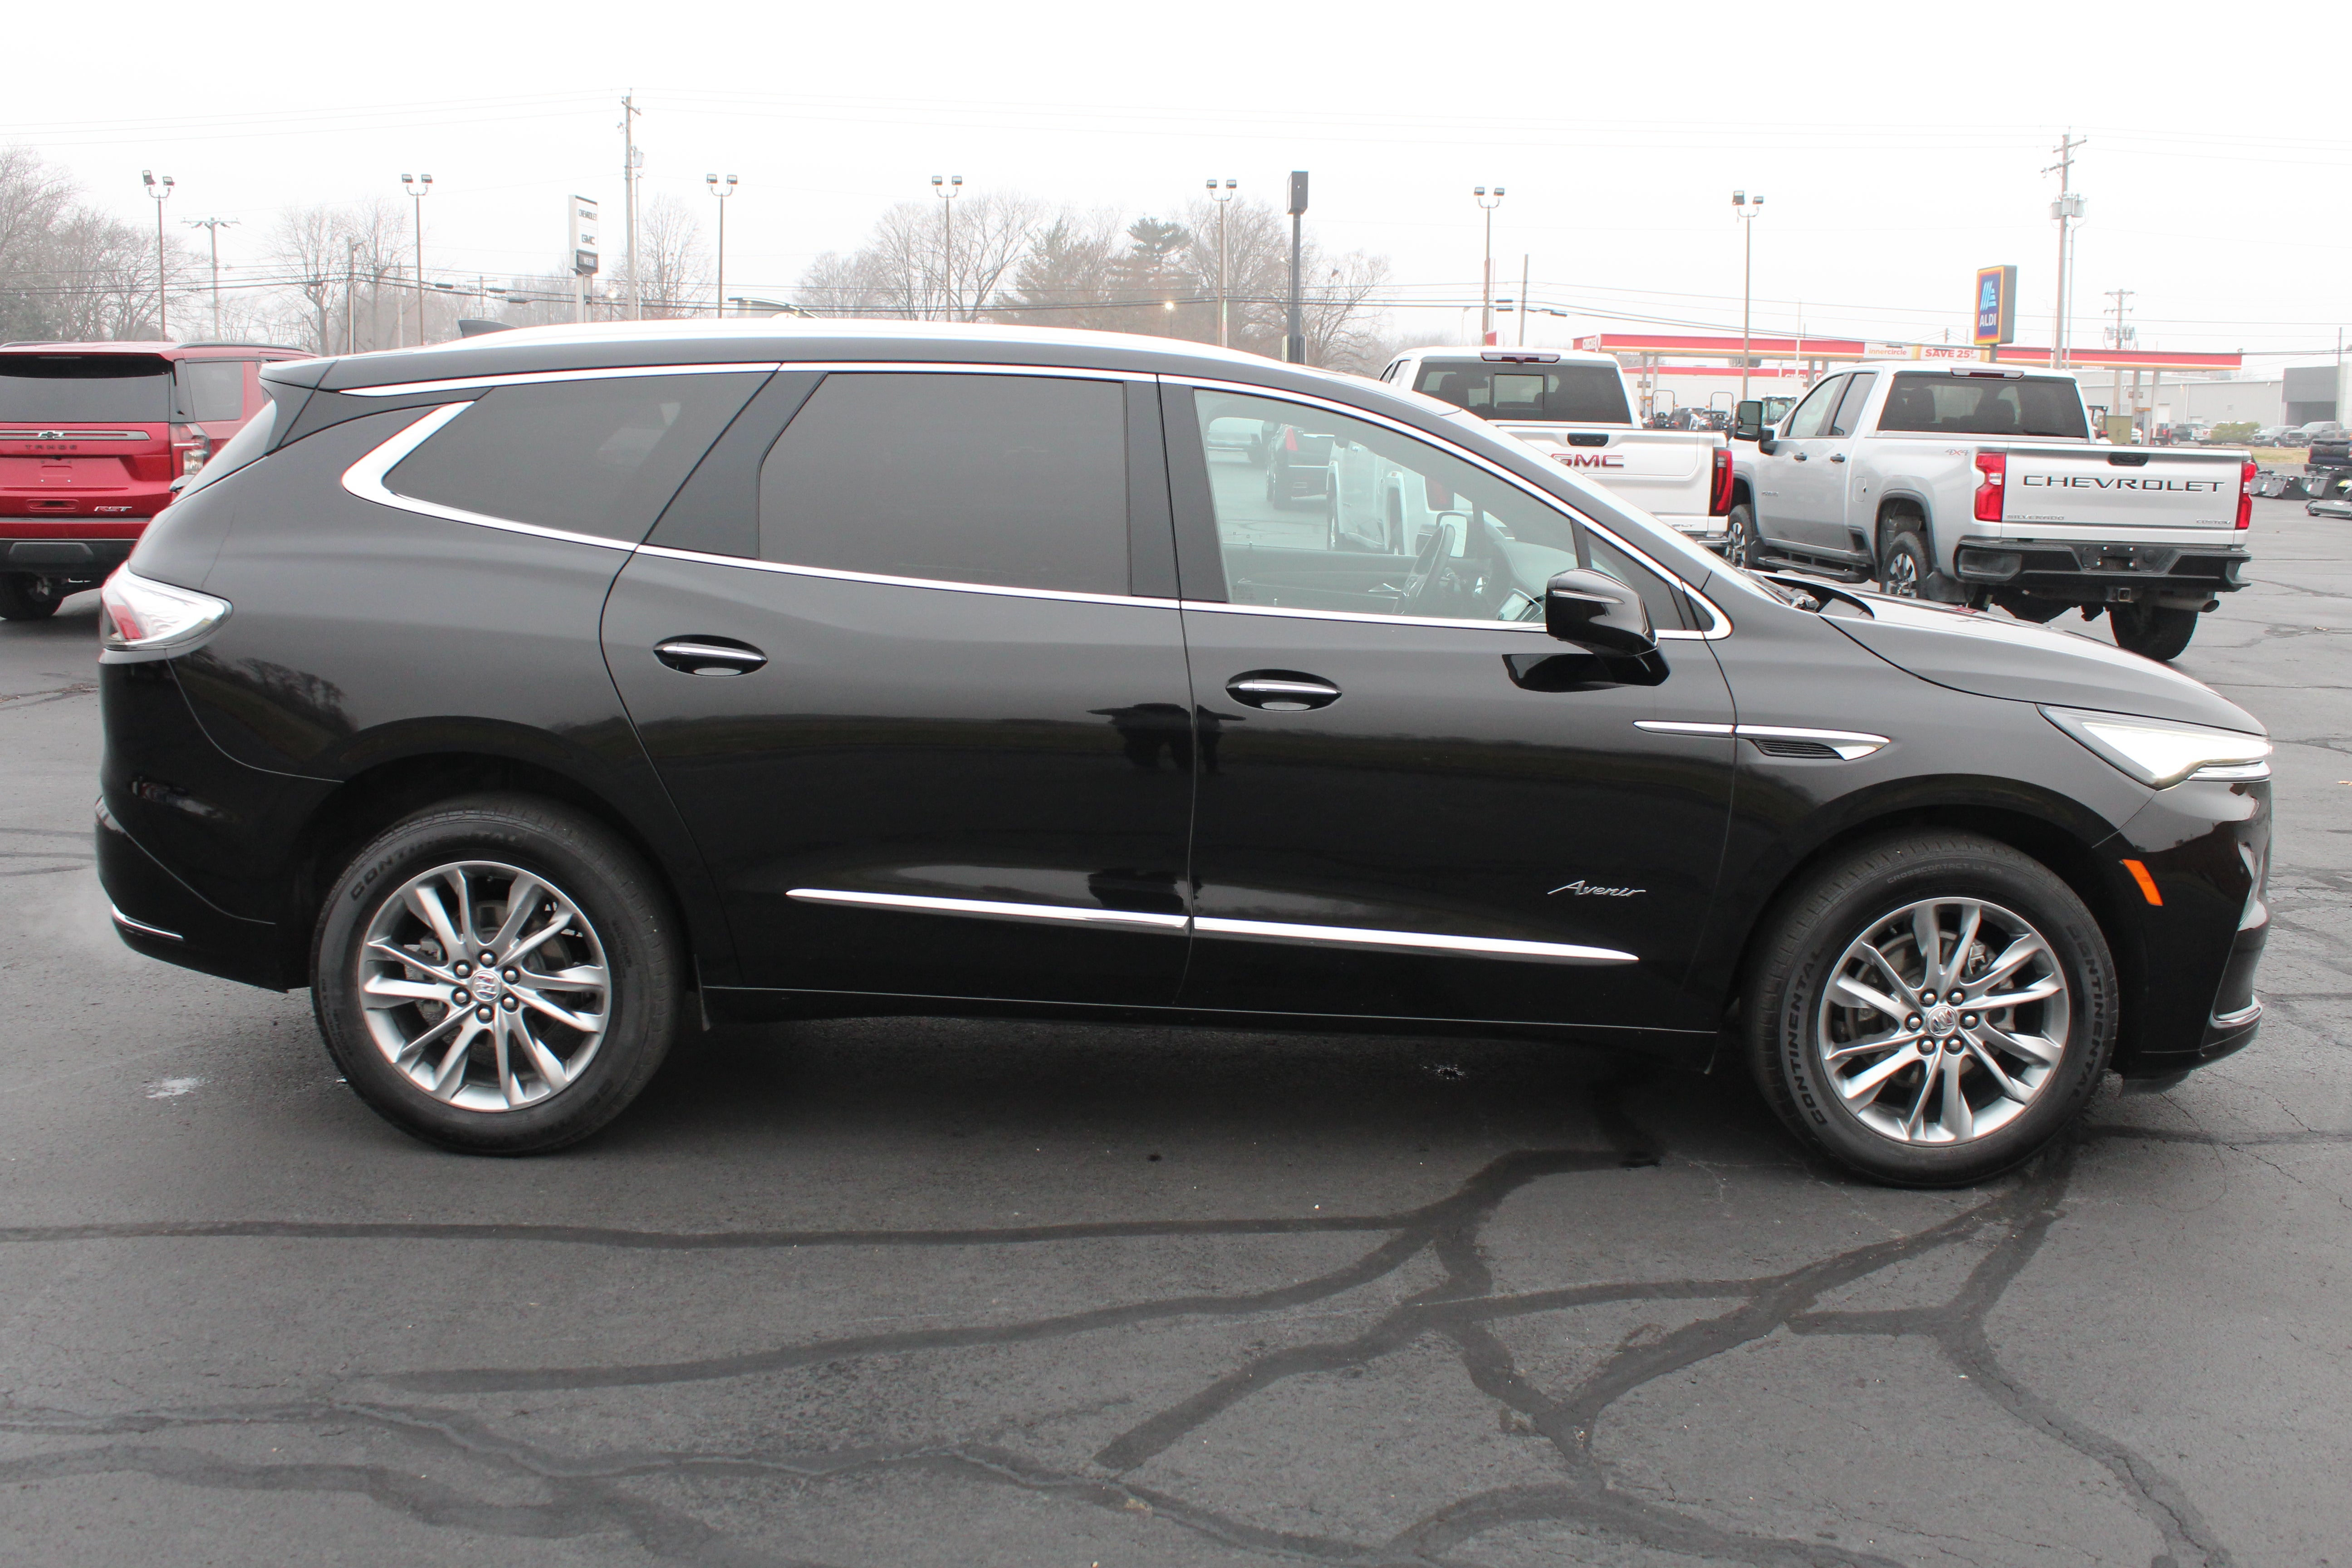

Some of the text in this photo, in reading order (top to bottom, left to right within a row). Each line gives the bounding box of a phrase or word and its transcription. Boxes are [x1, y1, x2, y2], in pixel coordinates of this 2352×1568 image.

[578, 209, 597, 220] CHEVROLET
[582, 234, 596, 245] GMC
[1979, 313, 1997, 327] ALDI
[1925, 348, 1955, 358] SAVE
[1550, 453, 1624, 468] GMC
[2023, 475, 2225, 493] CHEVROLET
[1886, 862, 1970, 884] CROSSCONTACT
[1547, 880, 1646, 897] Avenir
[1787, 946, 1828, 1127] CONTINENTAL
